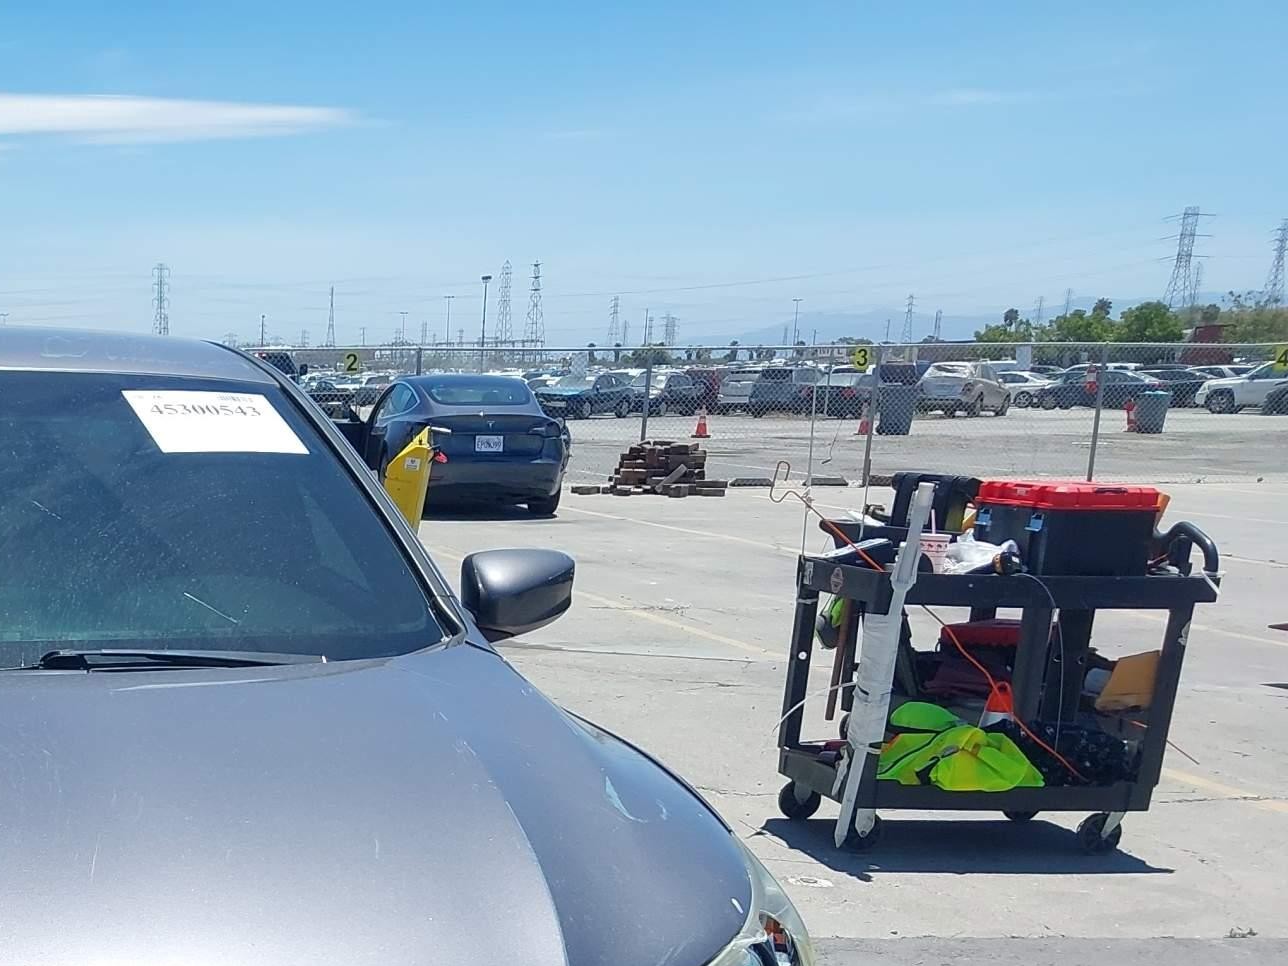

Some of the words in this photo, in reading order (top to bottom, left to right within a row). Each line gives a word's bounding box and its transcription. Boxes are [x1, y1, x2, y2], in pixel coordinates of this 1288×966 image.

[346, 354, 358, 371] 2
[857, 349, 868, 366] 3
[1277, 349, 1288, 367] 4
[150, 404, 261, 416] 45300543
